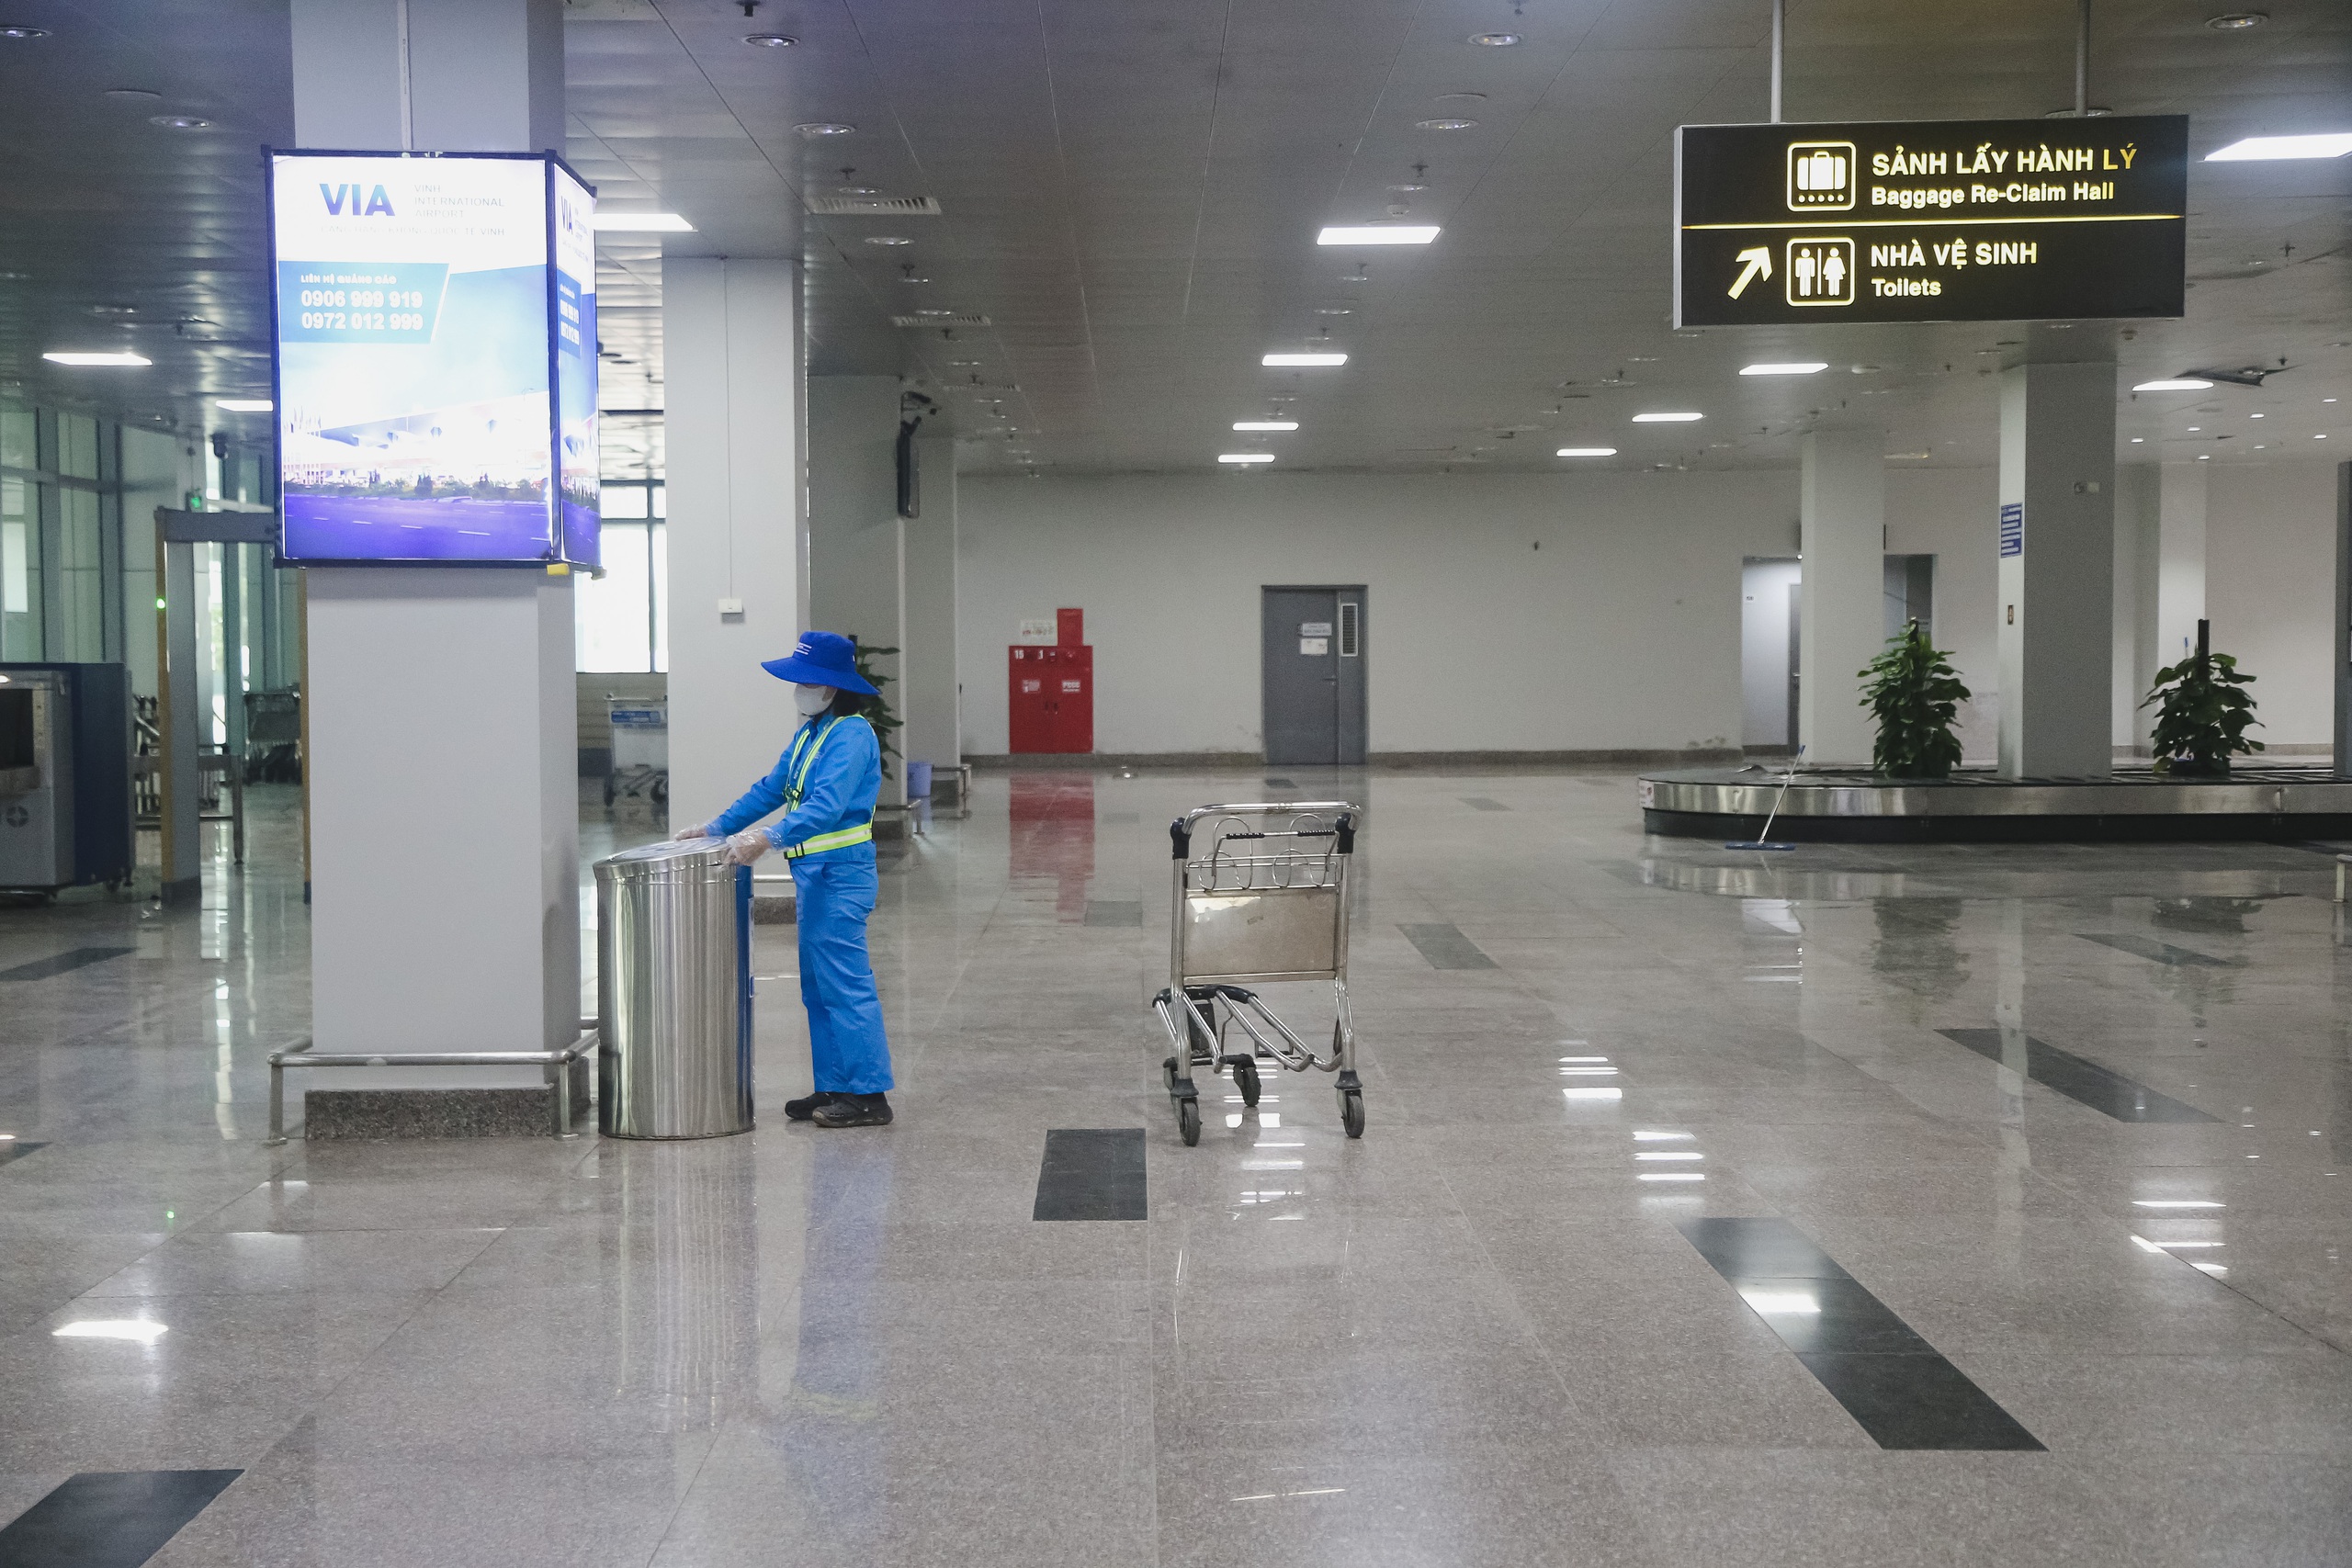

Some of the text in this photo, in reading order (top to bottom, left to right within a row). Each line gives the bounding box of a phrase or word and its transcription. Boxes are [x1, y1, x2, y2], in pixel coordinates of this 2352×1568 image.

[1871, 141, 2137, 176] SẢNH LẤY HÀNH LÝ
[413, 184, 441, 193] VINH
[1871, 181, 2114, 209] Baggage Re-Claim Hall
[319, 183, 396, 217] VIA
[414, 197, 505, 208] INTERNATIONAL
[414, 209, 465, 219] AIRPORT
[1871, 237, 2038, 270] NHÀ VỆ SINH
[1871, 277, 1942, 297] Toilets
[300, 289, 424, 309] 0906 999 919
[301, 312, 424, 331] 0972 012 999
